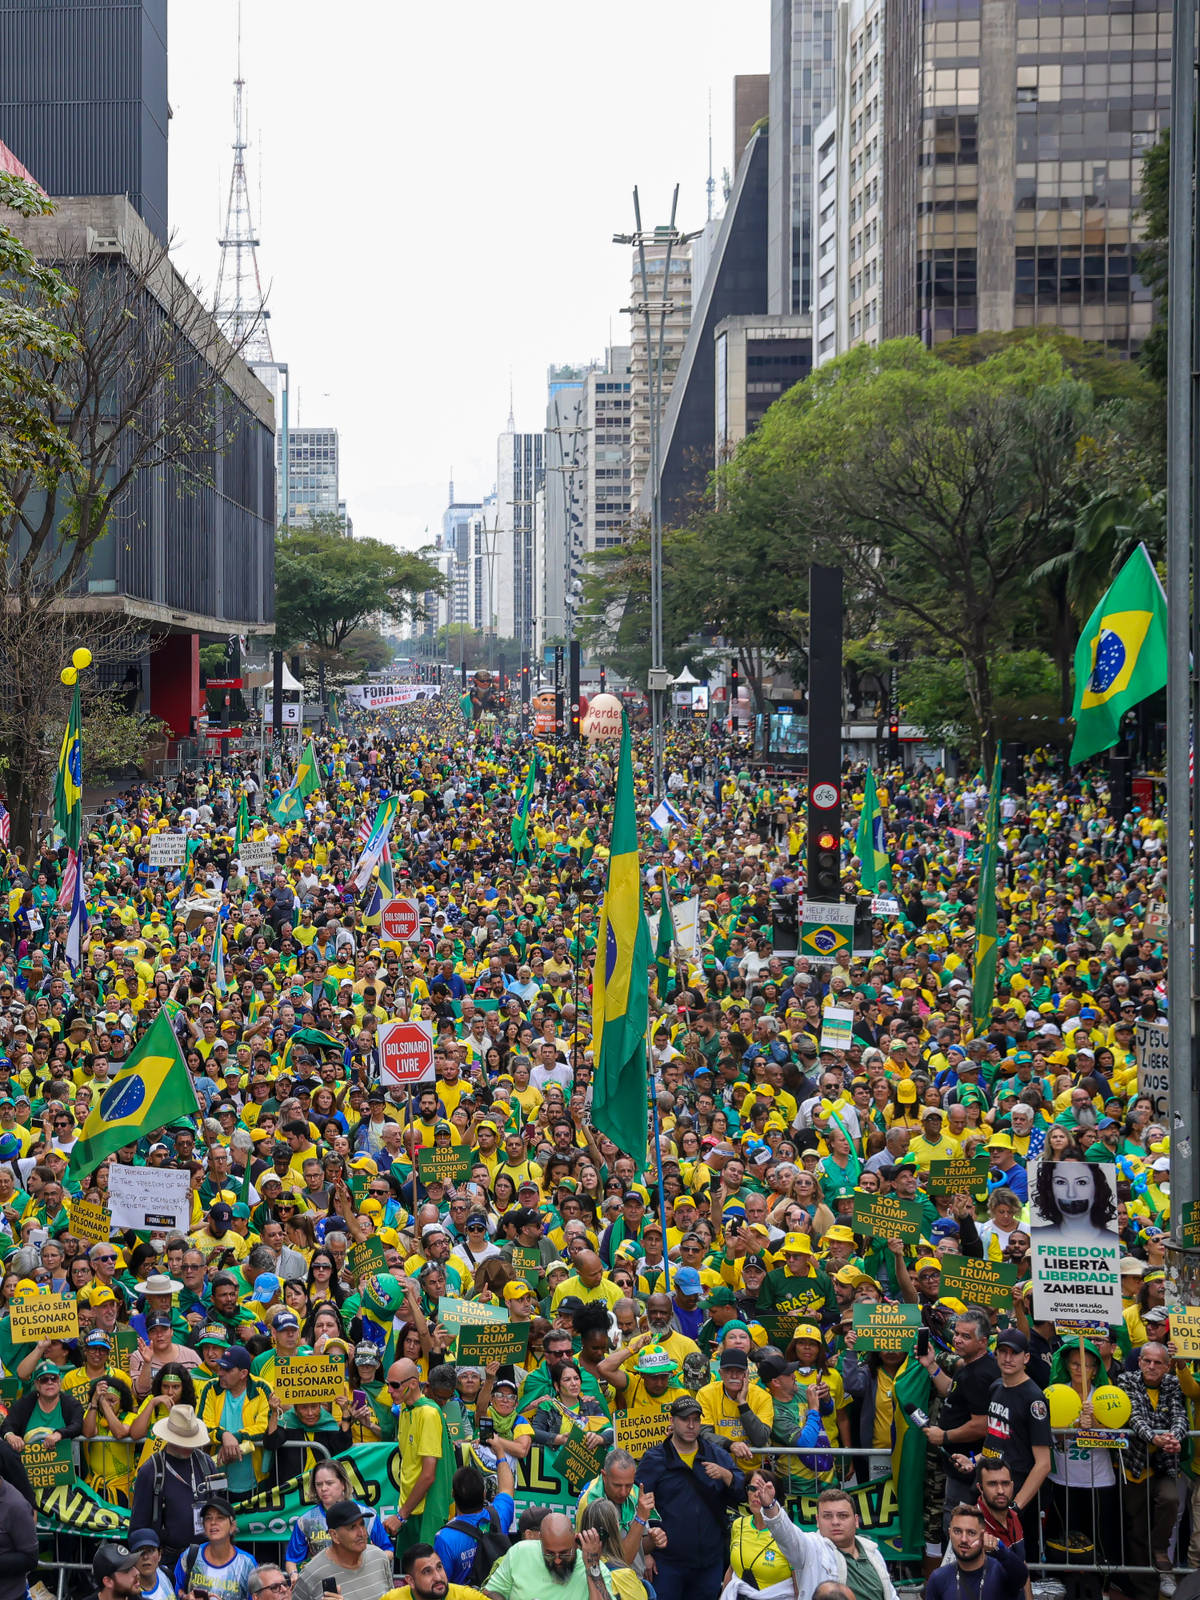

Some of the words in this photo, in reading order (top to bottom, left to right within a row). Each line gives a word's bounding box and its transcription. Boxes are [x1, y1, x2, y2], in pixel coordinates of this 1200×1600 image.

[363, 686, 394, 698] FORA
[370, 693, 412, 706] BUZINE!
[288, 708, 295, 718] 5
[385, 913, 415, 922] BOLSONARO
[392, 924, 409, 934] LIVRE
[386, 1040, 428, 1056] BOLSONARO
[395, 1057, 420, 1073] LIVRE
[431, 1153, 460, 1163] TRUMP
[422, 1164, 468, 1173] BOLSONARO
[943, 1167, 977, 1176] TRUMP
[436, 1170, 458, 1180] FREE
[931, 1177, 984, 1186] BOLSONARO
[945, 1185, 971, 1195] FREE
[877, 1196, 900, 1208] SOS
[95, 1213, 107, 1222] SEM
[870, 1204, 908, 1219] TRUMP
[70, 1213, 109, 1233] BOLSONARO
[857, 1214, 916, 1233] BOLSONARO
[872, 1226, 901, 1240] FREE
[354, 1243, 367, 1253] SOS
[1037, 1245, 1116, 1258] FREEDOM
[966, 1258, 992, 1270] SOS
[1044, 1257, 1110, 1271] LIBERTÀ
[959, 1266, 1000, 1282] TRUMP
[1038, 1270, 1118, 1283] LIBERDADE
[944, 1278, 1009, 1296] BOLSONARO
[1043, 1283, 1114, 1296] ZAMBELLI
[961, 1290, 992, 1305] FREE
[15, 1301, 51, 1315] ELEIÇÃO
[52, 1301, 71, 1311] SEM
[456, 1305, 494, 1317] TRUMP
[462, 1301, 485, 1309] SOS
[875, 1304, 899, 1314] SOS
[12, 1312, 76, 1326] BOLSONARO
[869, 1314, 907, 1325] TRUMP
[21, 1326, 27, 1337] É
[28, 1325, 71, 1336] DITADURA
[483, 1324, 507, 1333] SOS
[857, 1328, 916, 1338] BOLSONARO
[1057, 1327, 1108, 1336] BOLSONARO
[476, 1333, 515, 1343] TRUMP
[873, 1338, 902, 1350] FREE
[463, 1345, 522, 1355] BOLSONARO
[1183, 1339, 1189, 1350] É
[479, 1355, 507, 1365] FREE
[281, 1364, 317, 1376] ELEIÇÃO
[320, 1365, 338, 1373] SEM
[276, 1375, 343, 1387] BOLSONARO
[71, 1383, 90, 1396] SOS
[284, 1388, 290, 1398] É
[292, 1388, 336, 1398] DITADURA
[1106, 1401, 1121, 1411] JÁ!
[620, 1414, 651, 1428] ELEIÇÃO
[653, 1414, 670, 1423] SEM
[1077, 1430, 1100, 1438] VOLTA
[1078, 1439, 1127, 1448] BOLSONARO
[21, 1451, 58, 1464] TRUMP
[1068, 1449, 1091, 1461] 26
[565, 1458, 587, 1479] TRUMP
[566, 1469, 580, 1485] SOS
